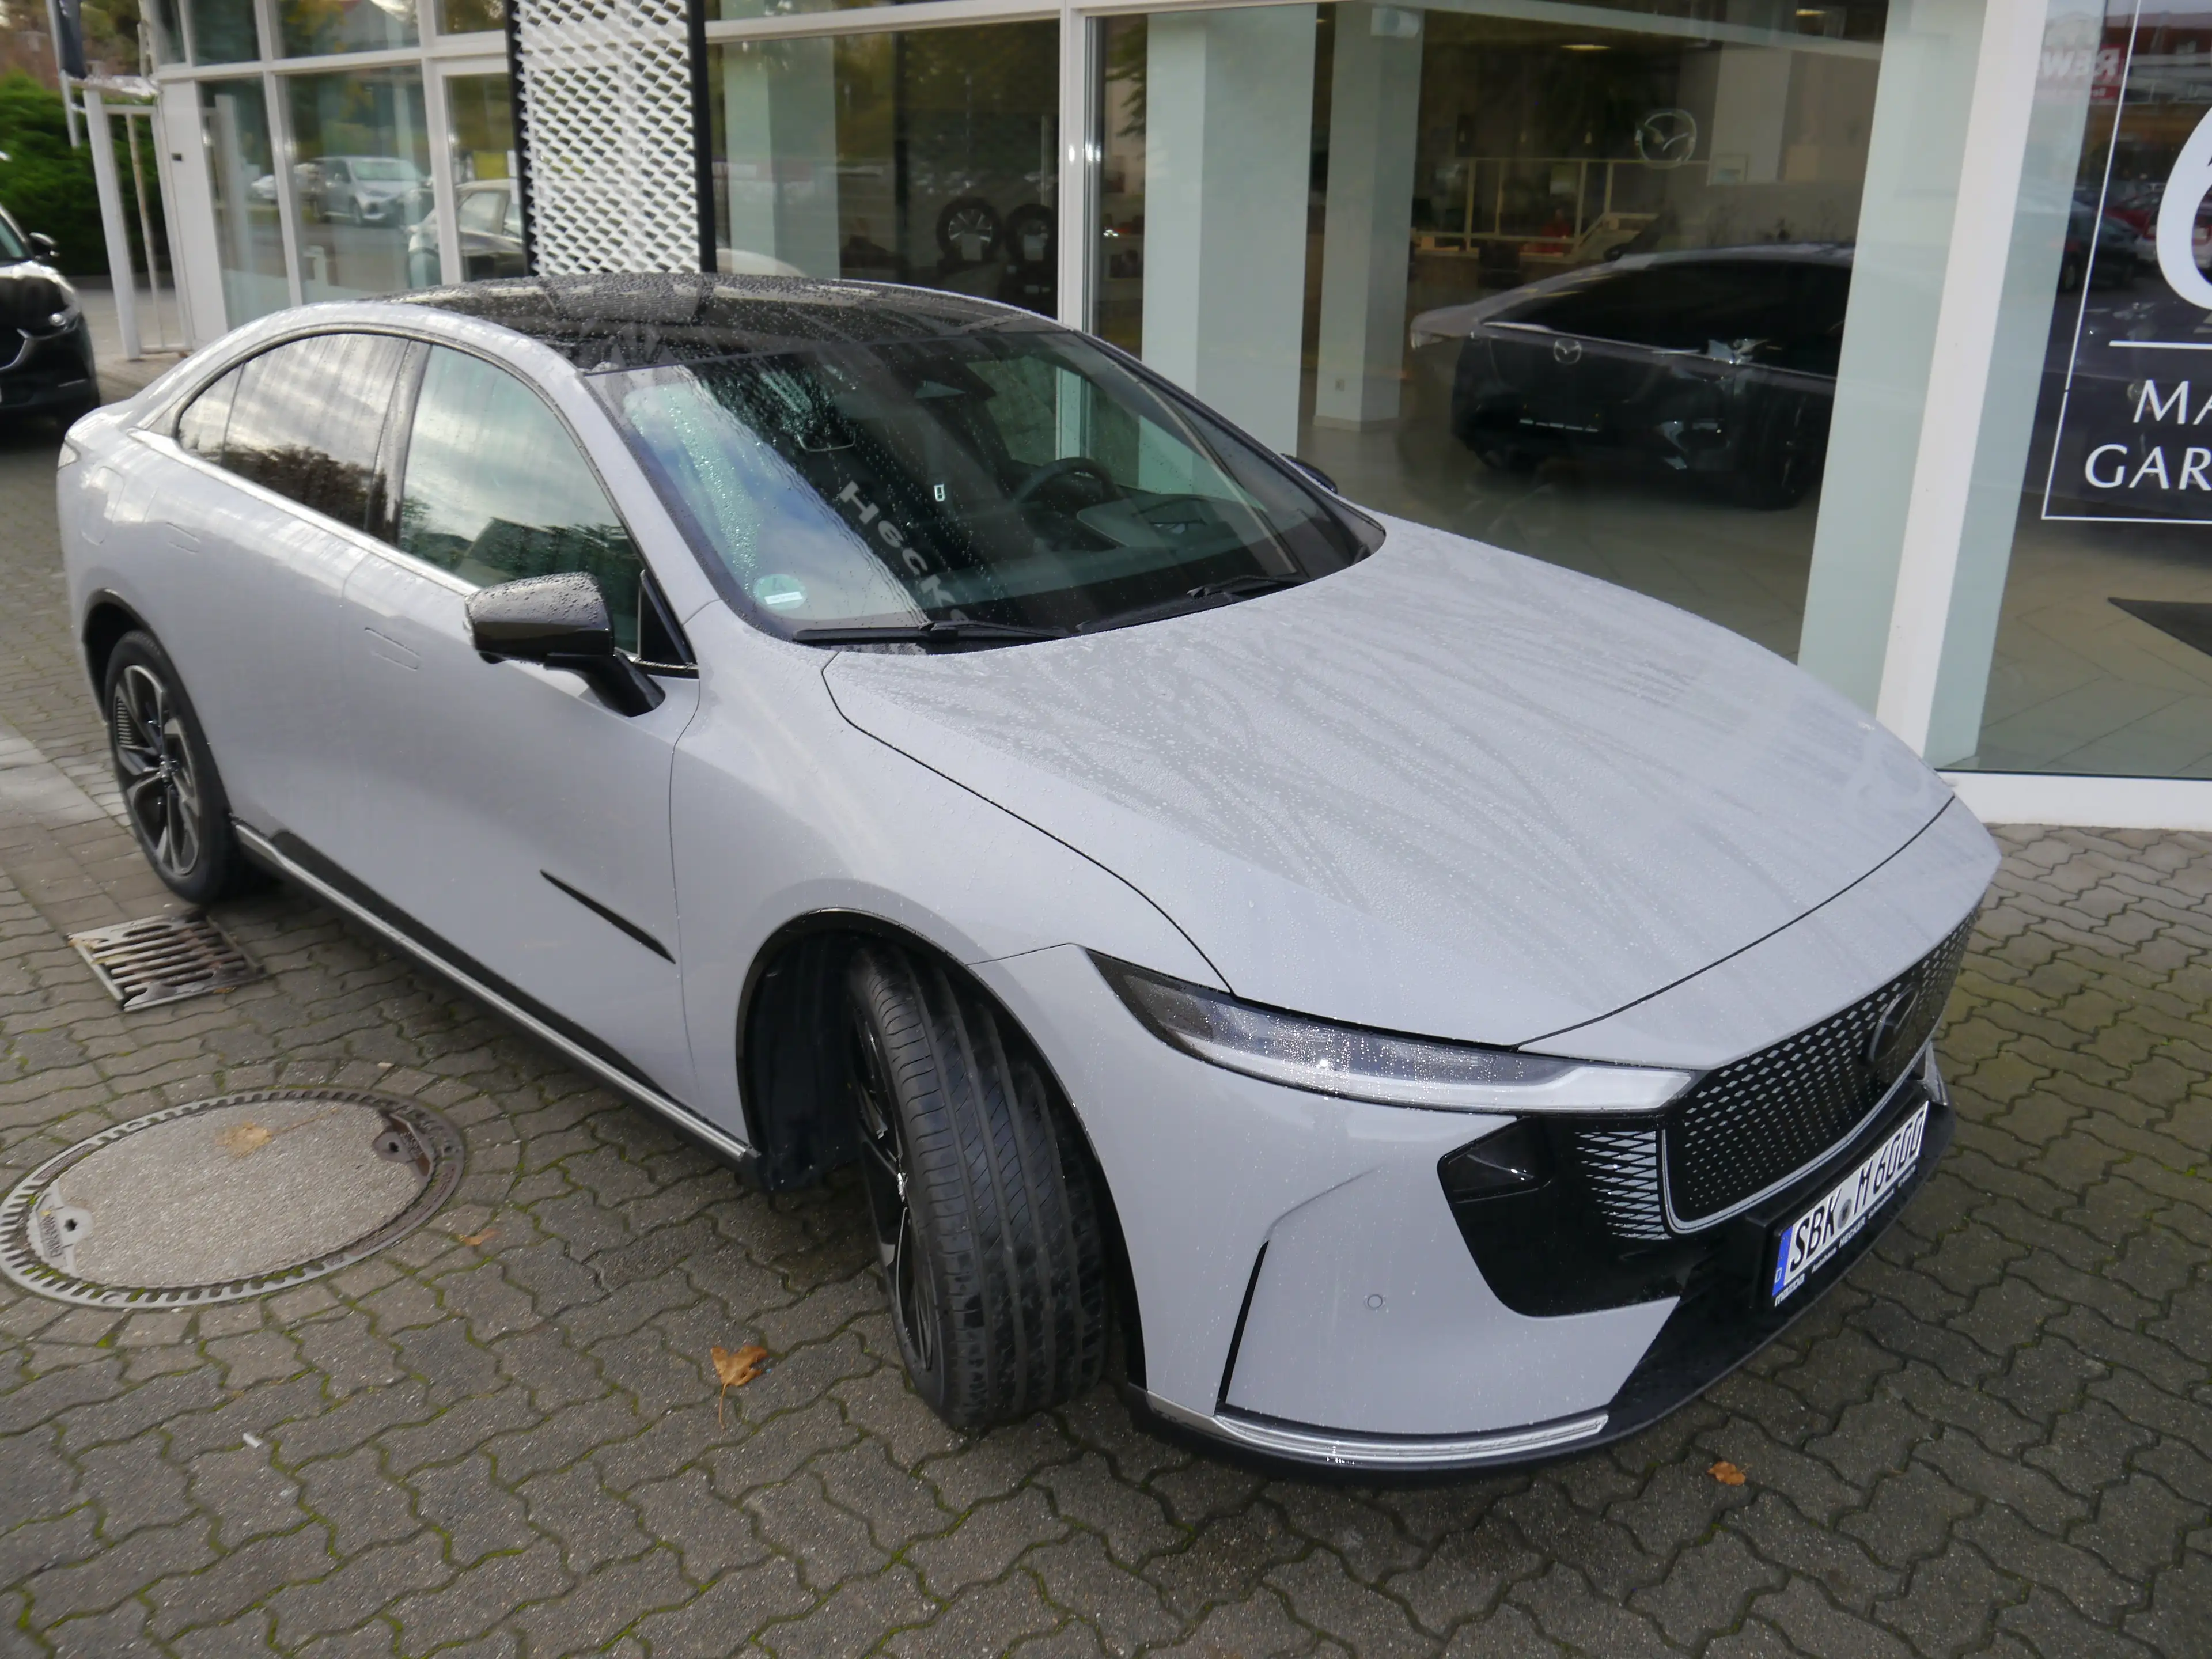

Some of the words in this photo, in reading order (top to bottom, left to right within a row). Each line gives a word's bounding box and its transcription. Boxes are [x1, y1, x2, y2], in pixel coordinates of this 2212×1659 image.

[2084, 444, 2212, 491] GAR
[1774, 1267, 1782, 1285] D
[1790, 1188, 1842, 1272] SBK
[1839, 1216, 1866, 1248] HECKER
